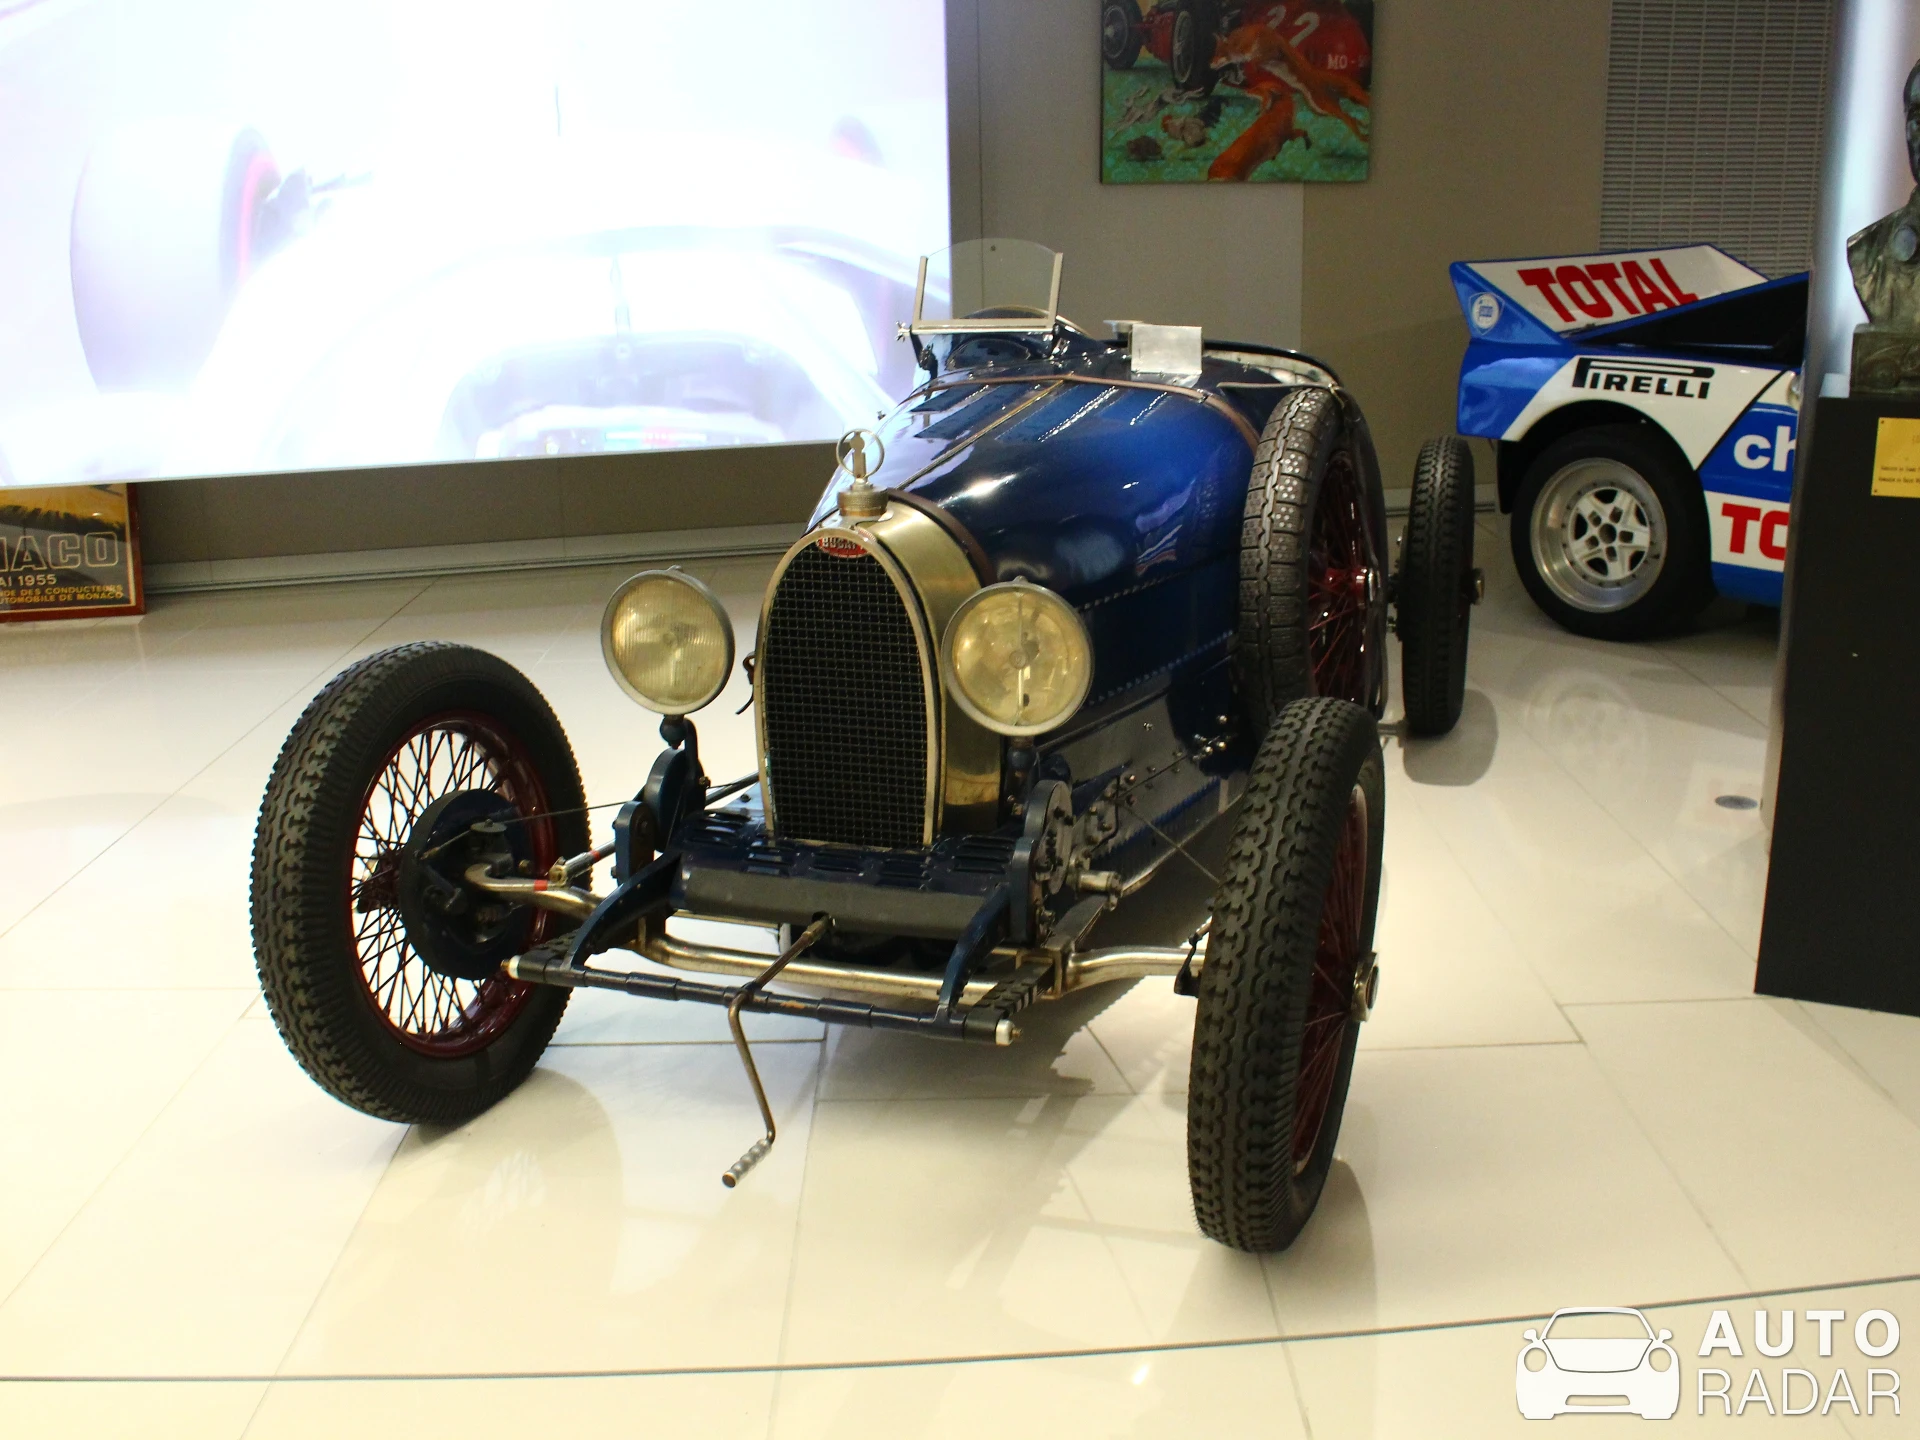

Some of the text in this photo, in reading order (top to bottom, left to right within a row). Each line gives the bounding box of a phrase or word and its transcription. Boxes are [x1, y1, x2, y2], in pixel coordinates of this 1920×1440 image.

[1517, 258, 1699, 323] TOTAL
[1572, 357, 1716, 399] PIRELLI
[18, 574, 57, 586] 1955
[77, 591, 124, 600] MONACO
